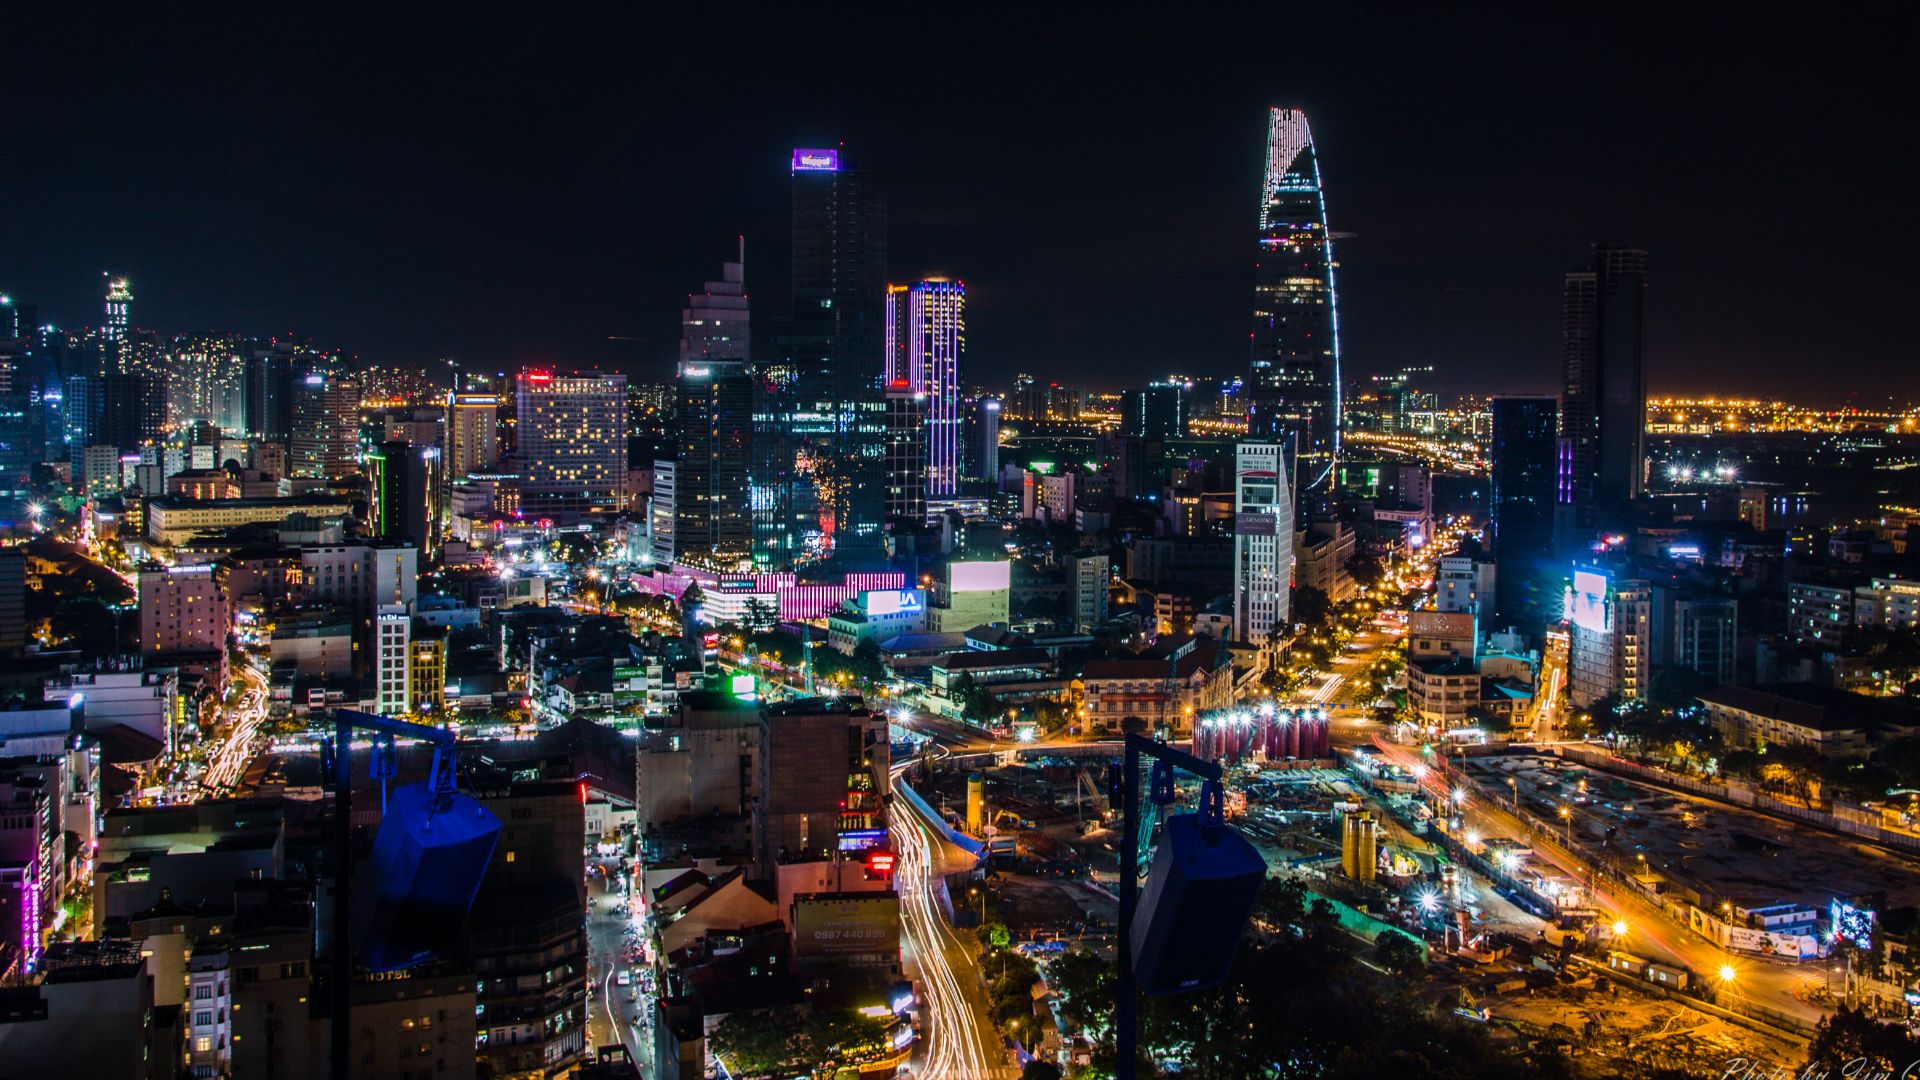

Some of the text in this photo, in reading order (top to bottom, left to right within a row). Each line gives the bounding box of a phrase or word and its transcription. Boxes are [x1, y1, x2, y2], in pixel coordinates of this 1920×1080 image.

[814, 930, 841, 940] 0987
[842, 930, 863, 939] 440
[366, 968, 411, 981] HOTEL
